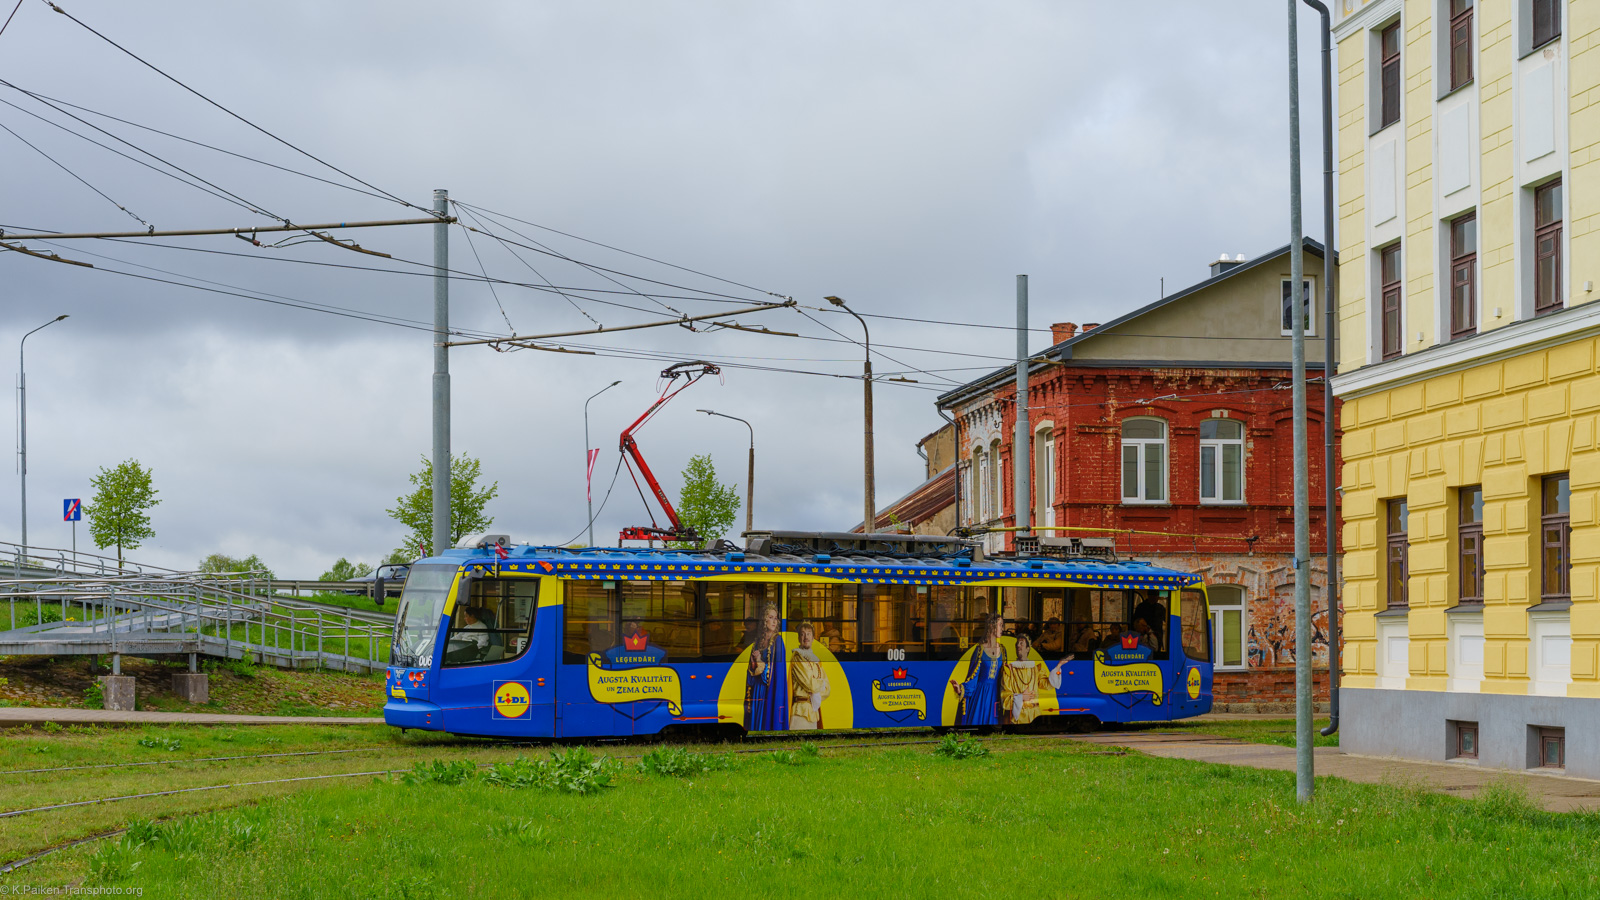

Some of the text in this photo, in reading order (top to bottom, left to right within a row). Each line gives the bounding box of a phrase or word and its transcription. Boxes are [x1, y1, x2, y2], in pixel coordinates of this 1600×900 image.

[887, 648, 905, 661] 006
[615, 656, 656, 664] LEĢENDĀRI
[597, 675, 673, 684] AUGSTA KVALITĀTE
[616, 686, 640, 694] ZEMA
